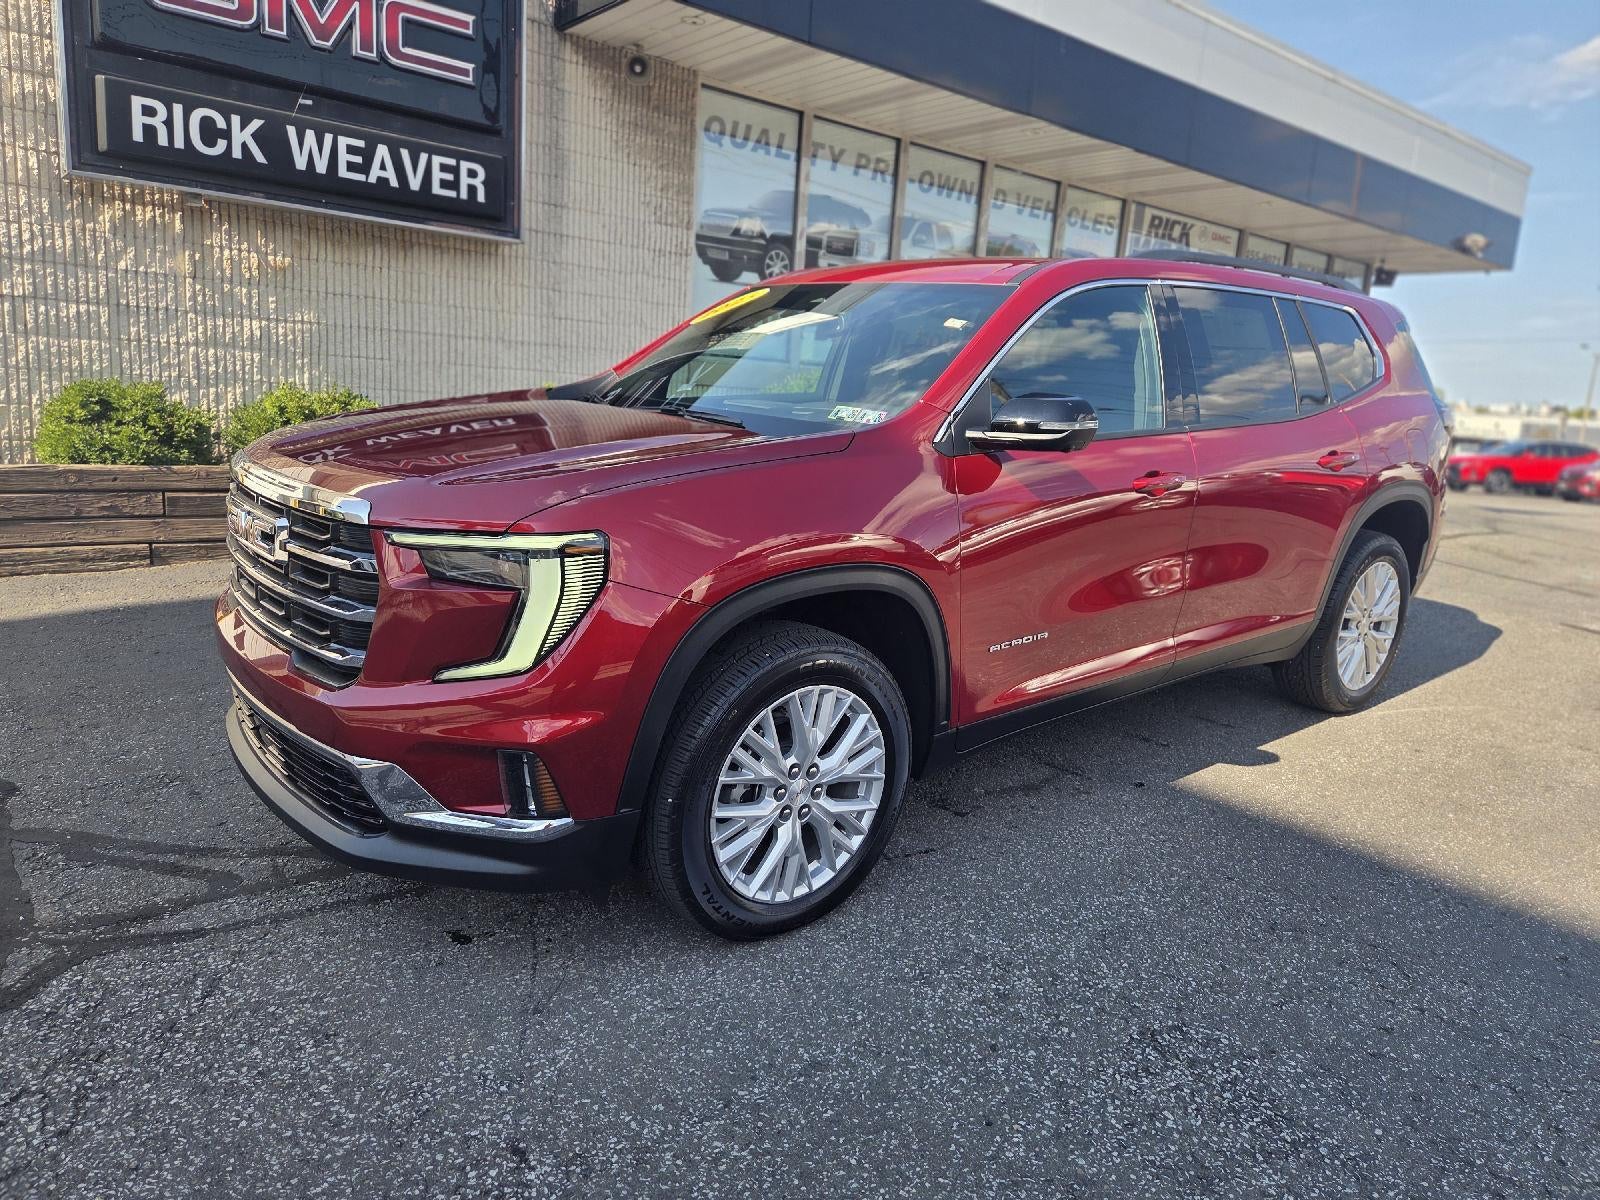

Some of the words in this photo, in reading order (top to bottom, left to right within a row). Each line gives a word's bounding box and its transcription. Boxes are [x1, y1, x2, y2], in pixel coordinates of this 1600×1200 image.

[130, 94, 268, 165] RICK
[286, 124, 486, 202] WEAVER
[703, 115, 846, 172] QUALTY
[1016, 190, 1117, 236] VEHCLES
[1144, 213, 1195, 249] RICK
[988, 631, 1049, 653] ACADIA
